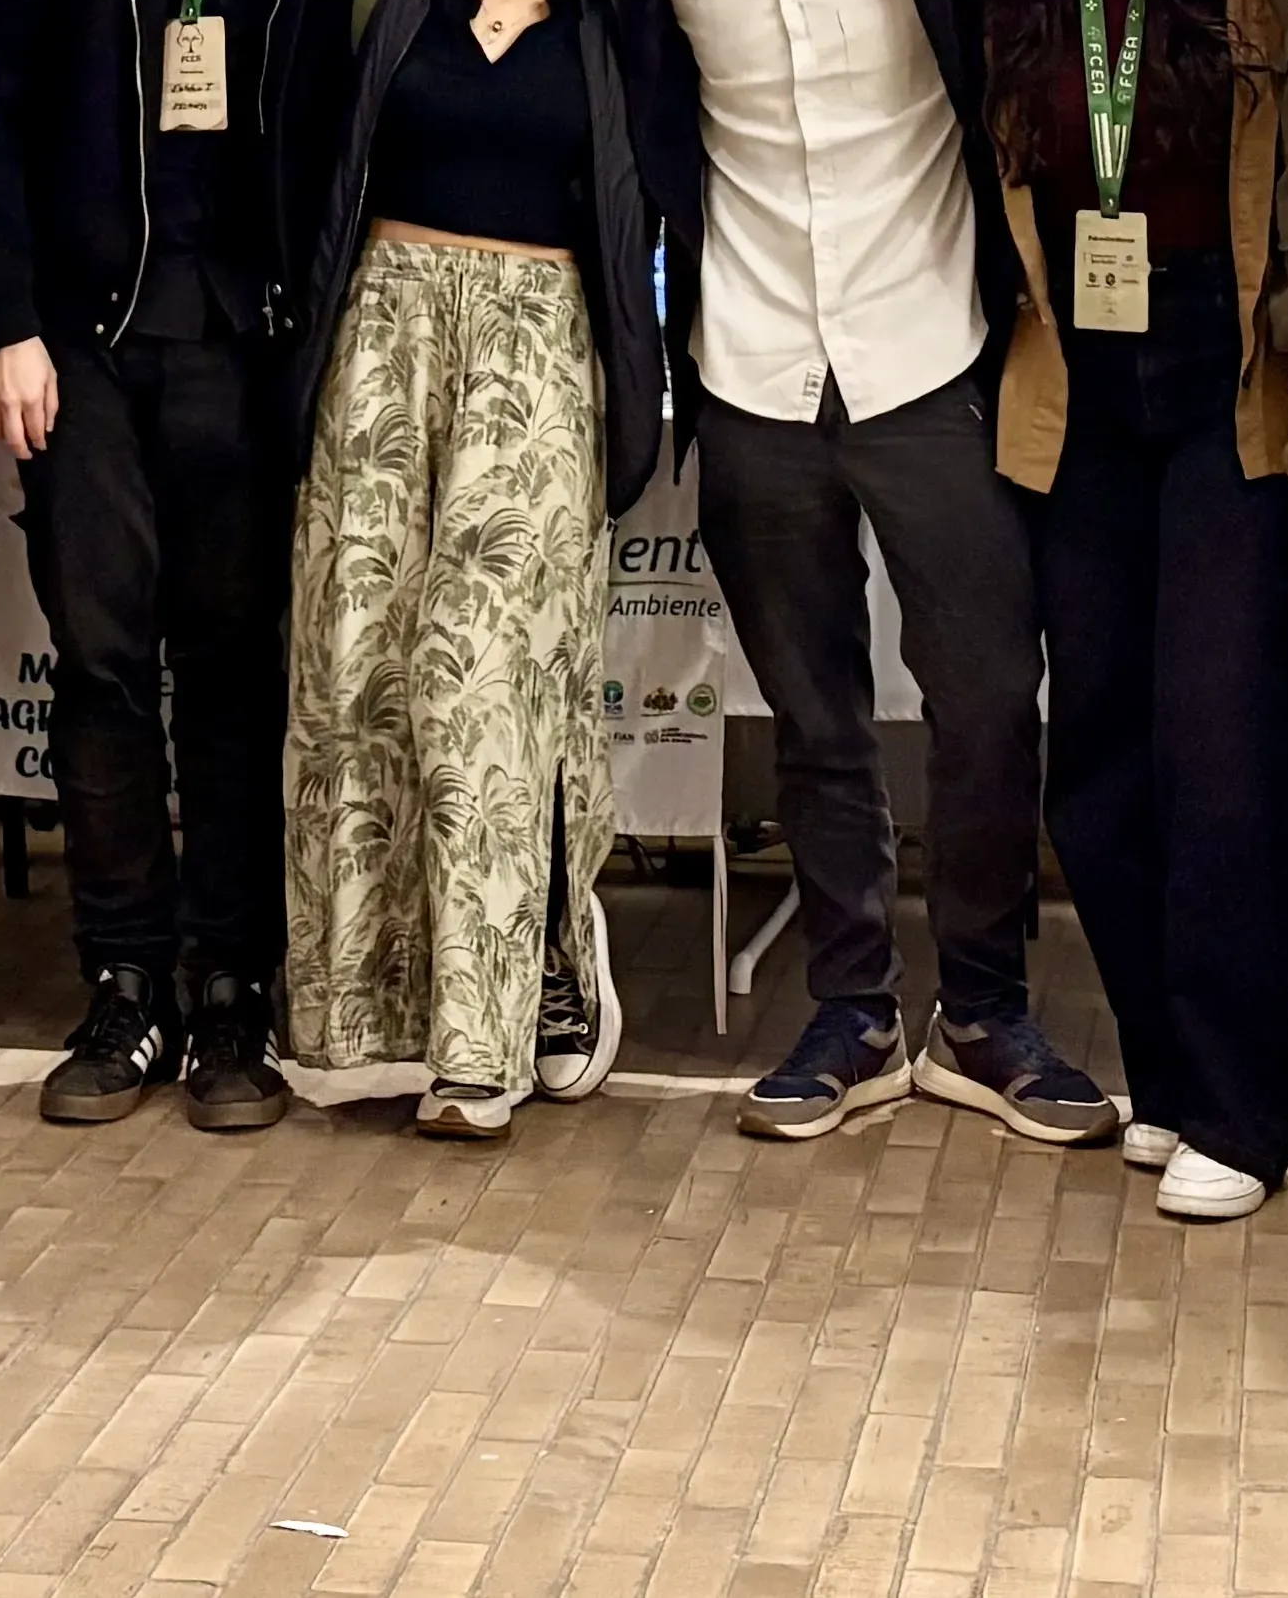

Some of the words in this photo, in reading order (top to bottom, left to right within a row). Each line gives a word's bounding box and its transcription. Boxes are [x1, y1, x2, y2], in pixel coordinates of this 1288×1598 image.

[1088, 43, 1105, 94] FCEA
[1119, 36, 1139, 88] FCEA
[608, 594, 721, 617] Ambiente
